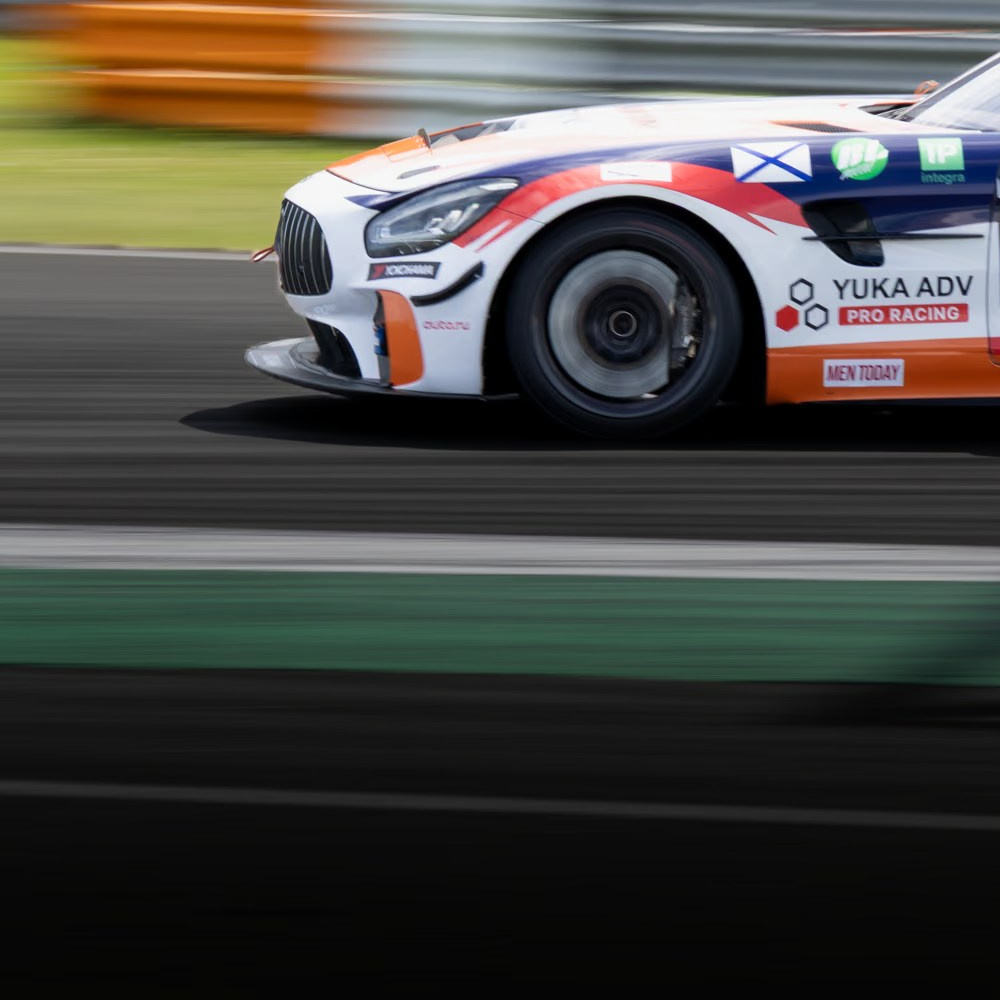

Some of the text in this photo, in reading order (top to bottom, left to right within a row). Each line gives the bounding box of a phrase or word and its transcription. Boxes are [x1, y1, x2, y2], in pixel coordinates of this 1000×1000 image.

[921, 172, 966, 186] integra
[832, 275, 974, 300] YUKA ADV
[847, 306, 960, 323] PRO RACING
[827, 364, 901, 381] MEN TODAY
